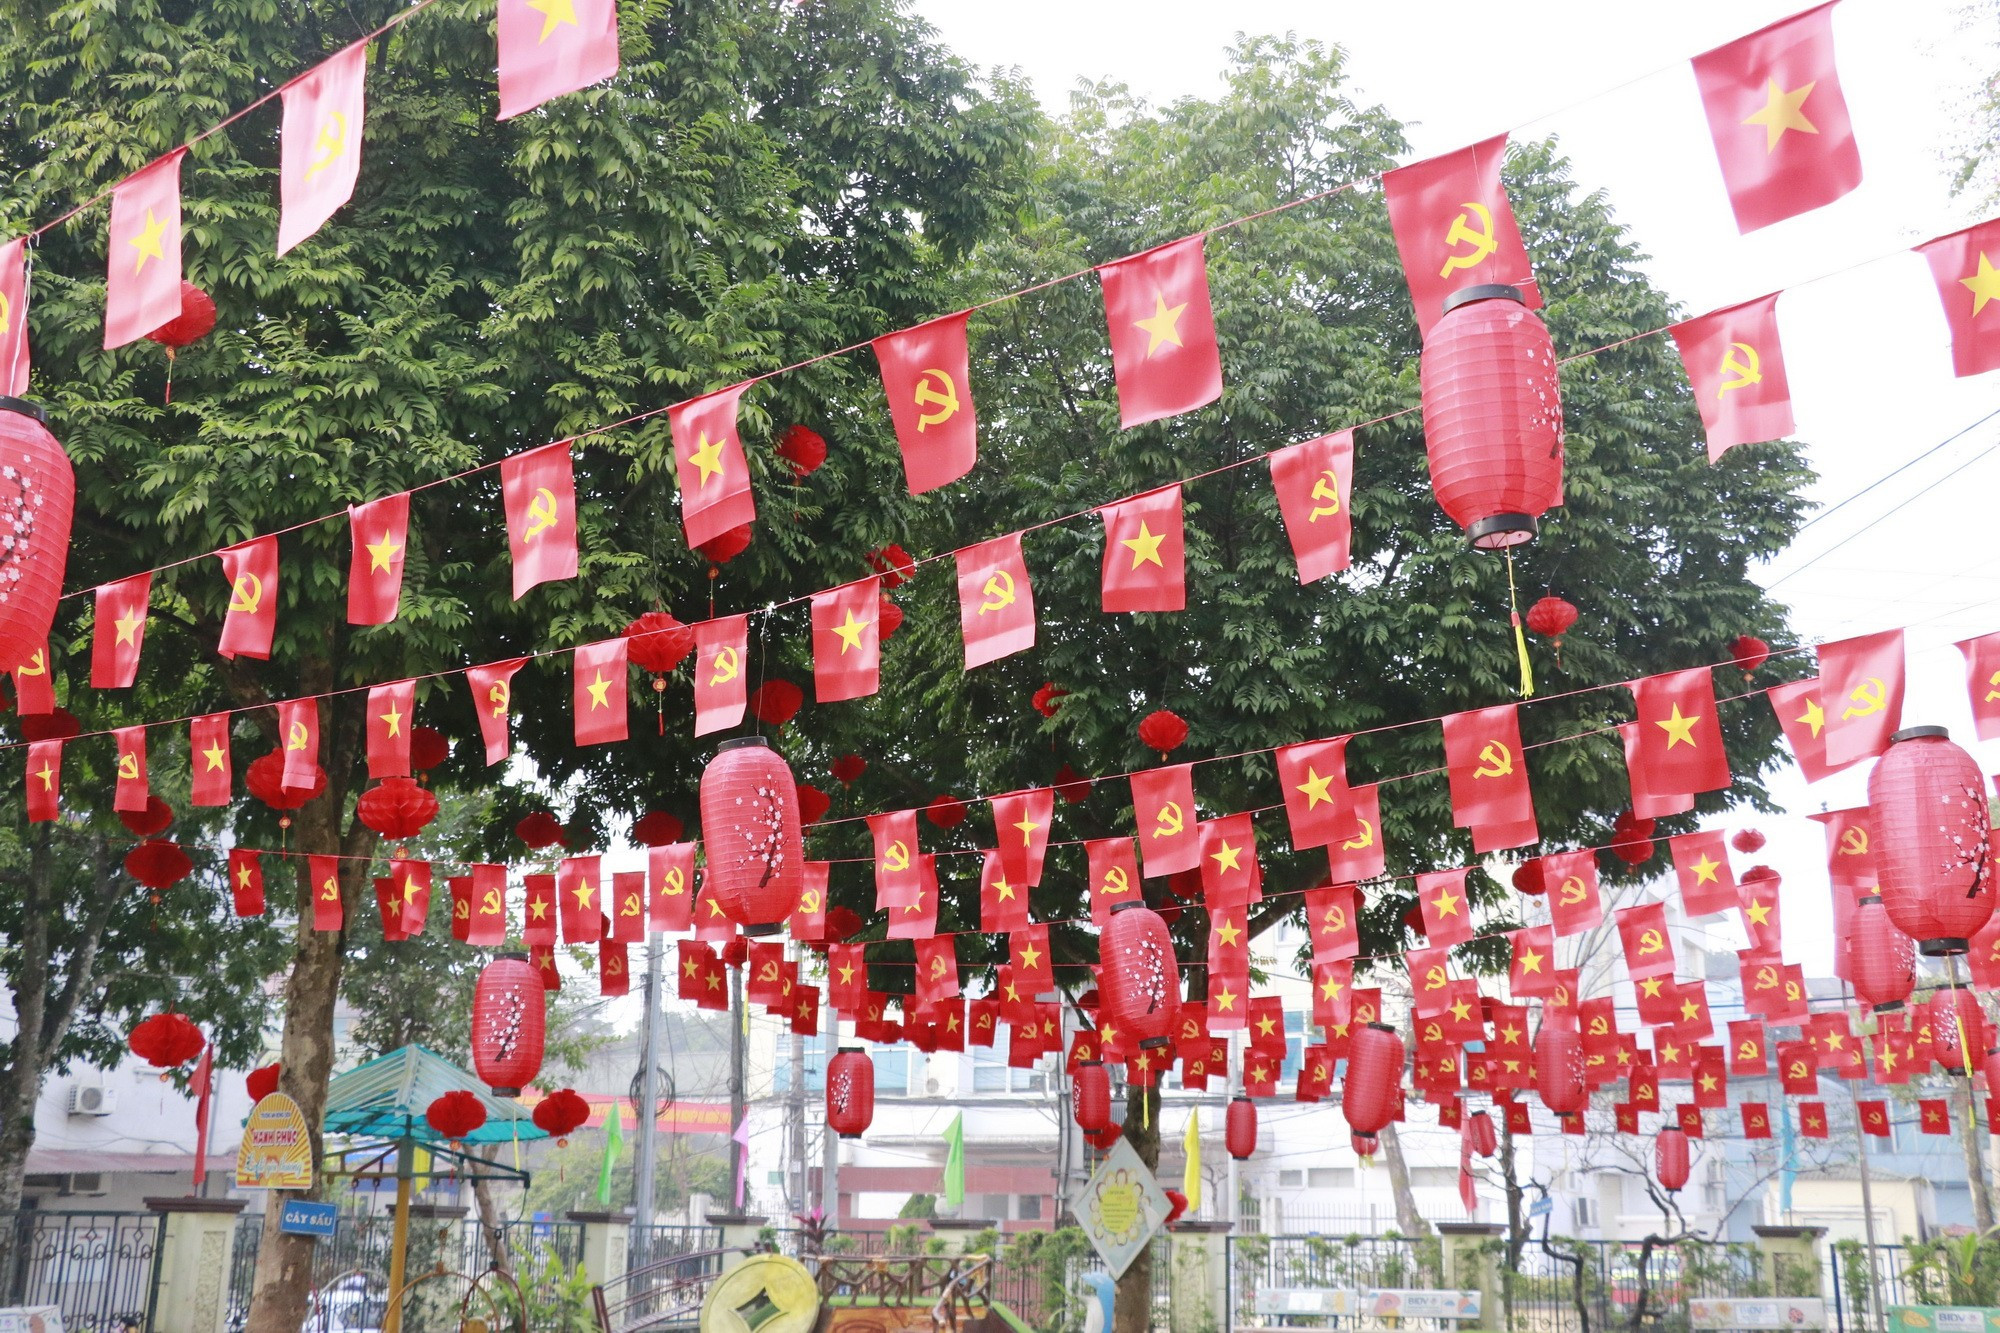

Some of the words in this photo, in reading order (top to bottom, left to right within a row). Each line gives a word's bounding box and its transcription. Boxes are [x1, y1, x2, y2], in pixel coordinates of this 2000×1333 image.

[285, 1211, 308, 1224] CÂY
[309, 1212, 333, 1227] SẤU
[1408, 1297, 1429, 1305] BIDV
[1939, 1313, 1966, 1322] BIDV
